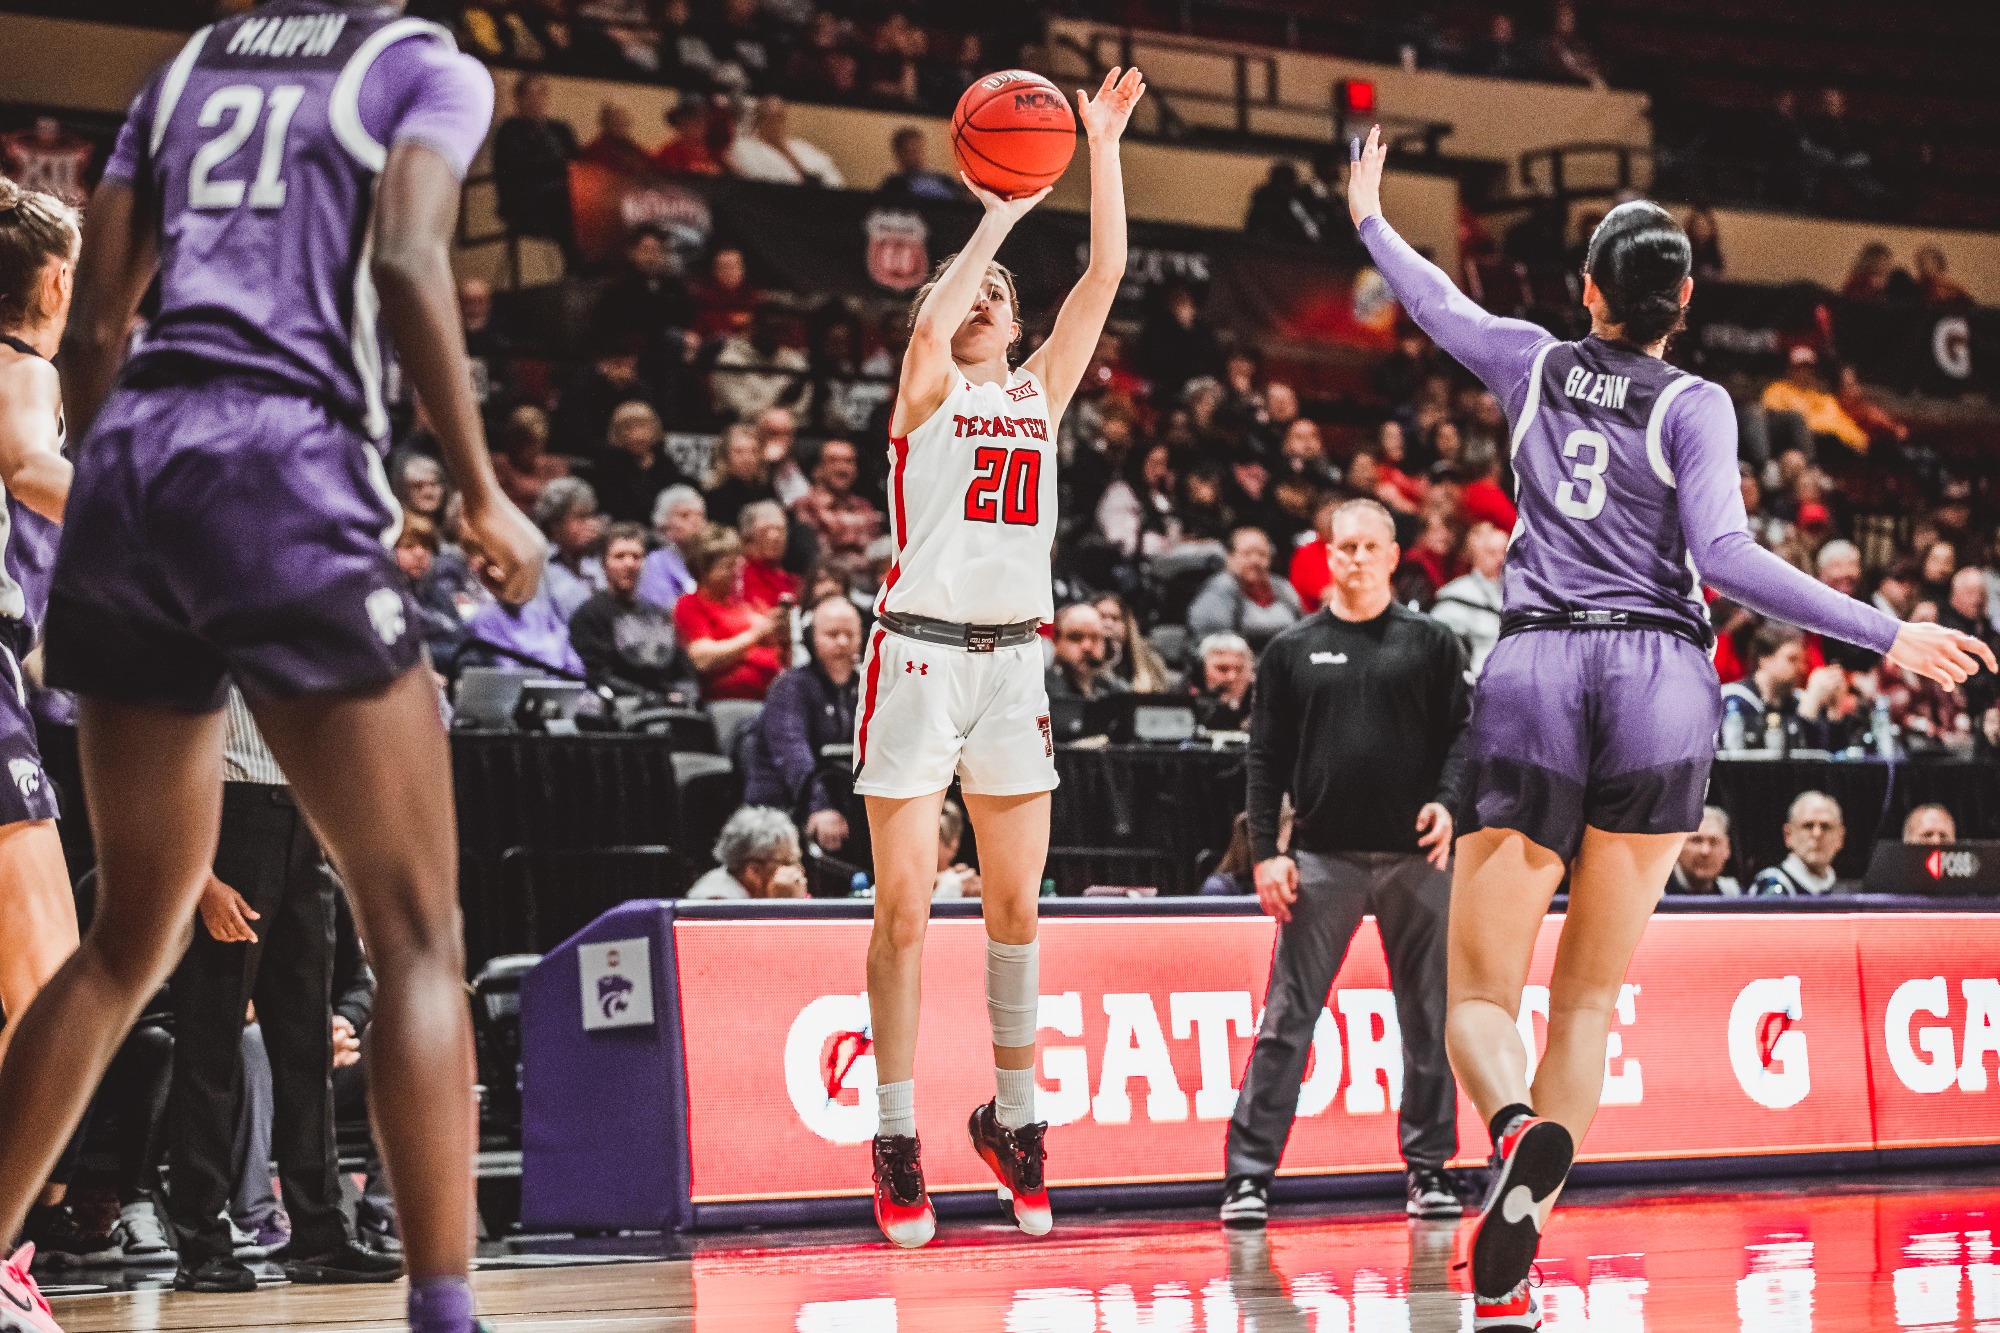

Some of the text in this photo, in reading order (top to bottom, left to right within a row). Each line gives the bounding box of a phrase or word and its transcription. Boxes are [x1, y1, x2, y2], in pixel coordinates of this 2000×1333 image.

[226, 13, 348, 57] MAUPIN
[188, 84, 305, 209] 21
[1564, 365, 1631, 409] GLENN
[953, 414, 1049, 442] TEXAS TECH
[964, 446, 1042, 527] 20
[1554, 429, 1610, 521] 3
[784, 991, 880, 1144] G
[1033, 983, 1644, 1127] GATORE
[1727, 976, 1811, 1109] G
